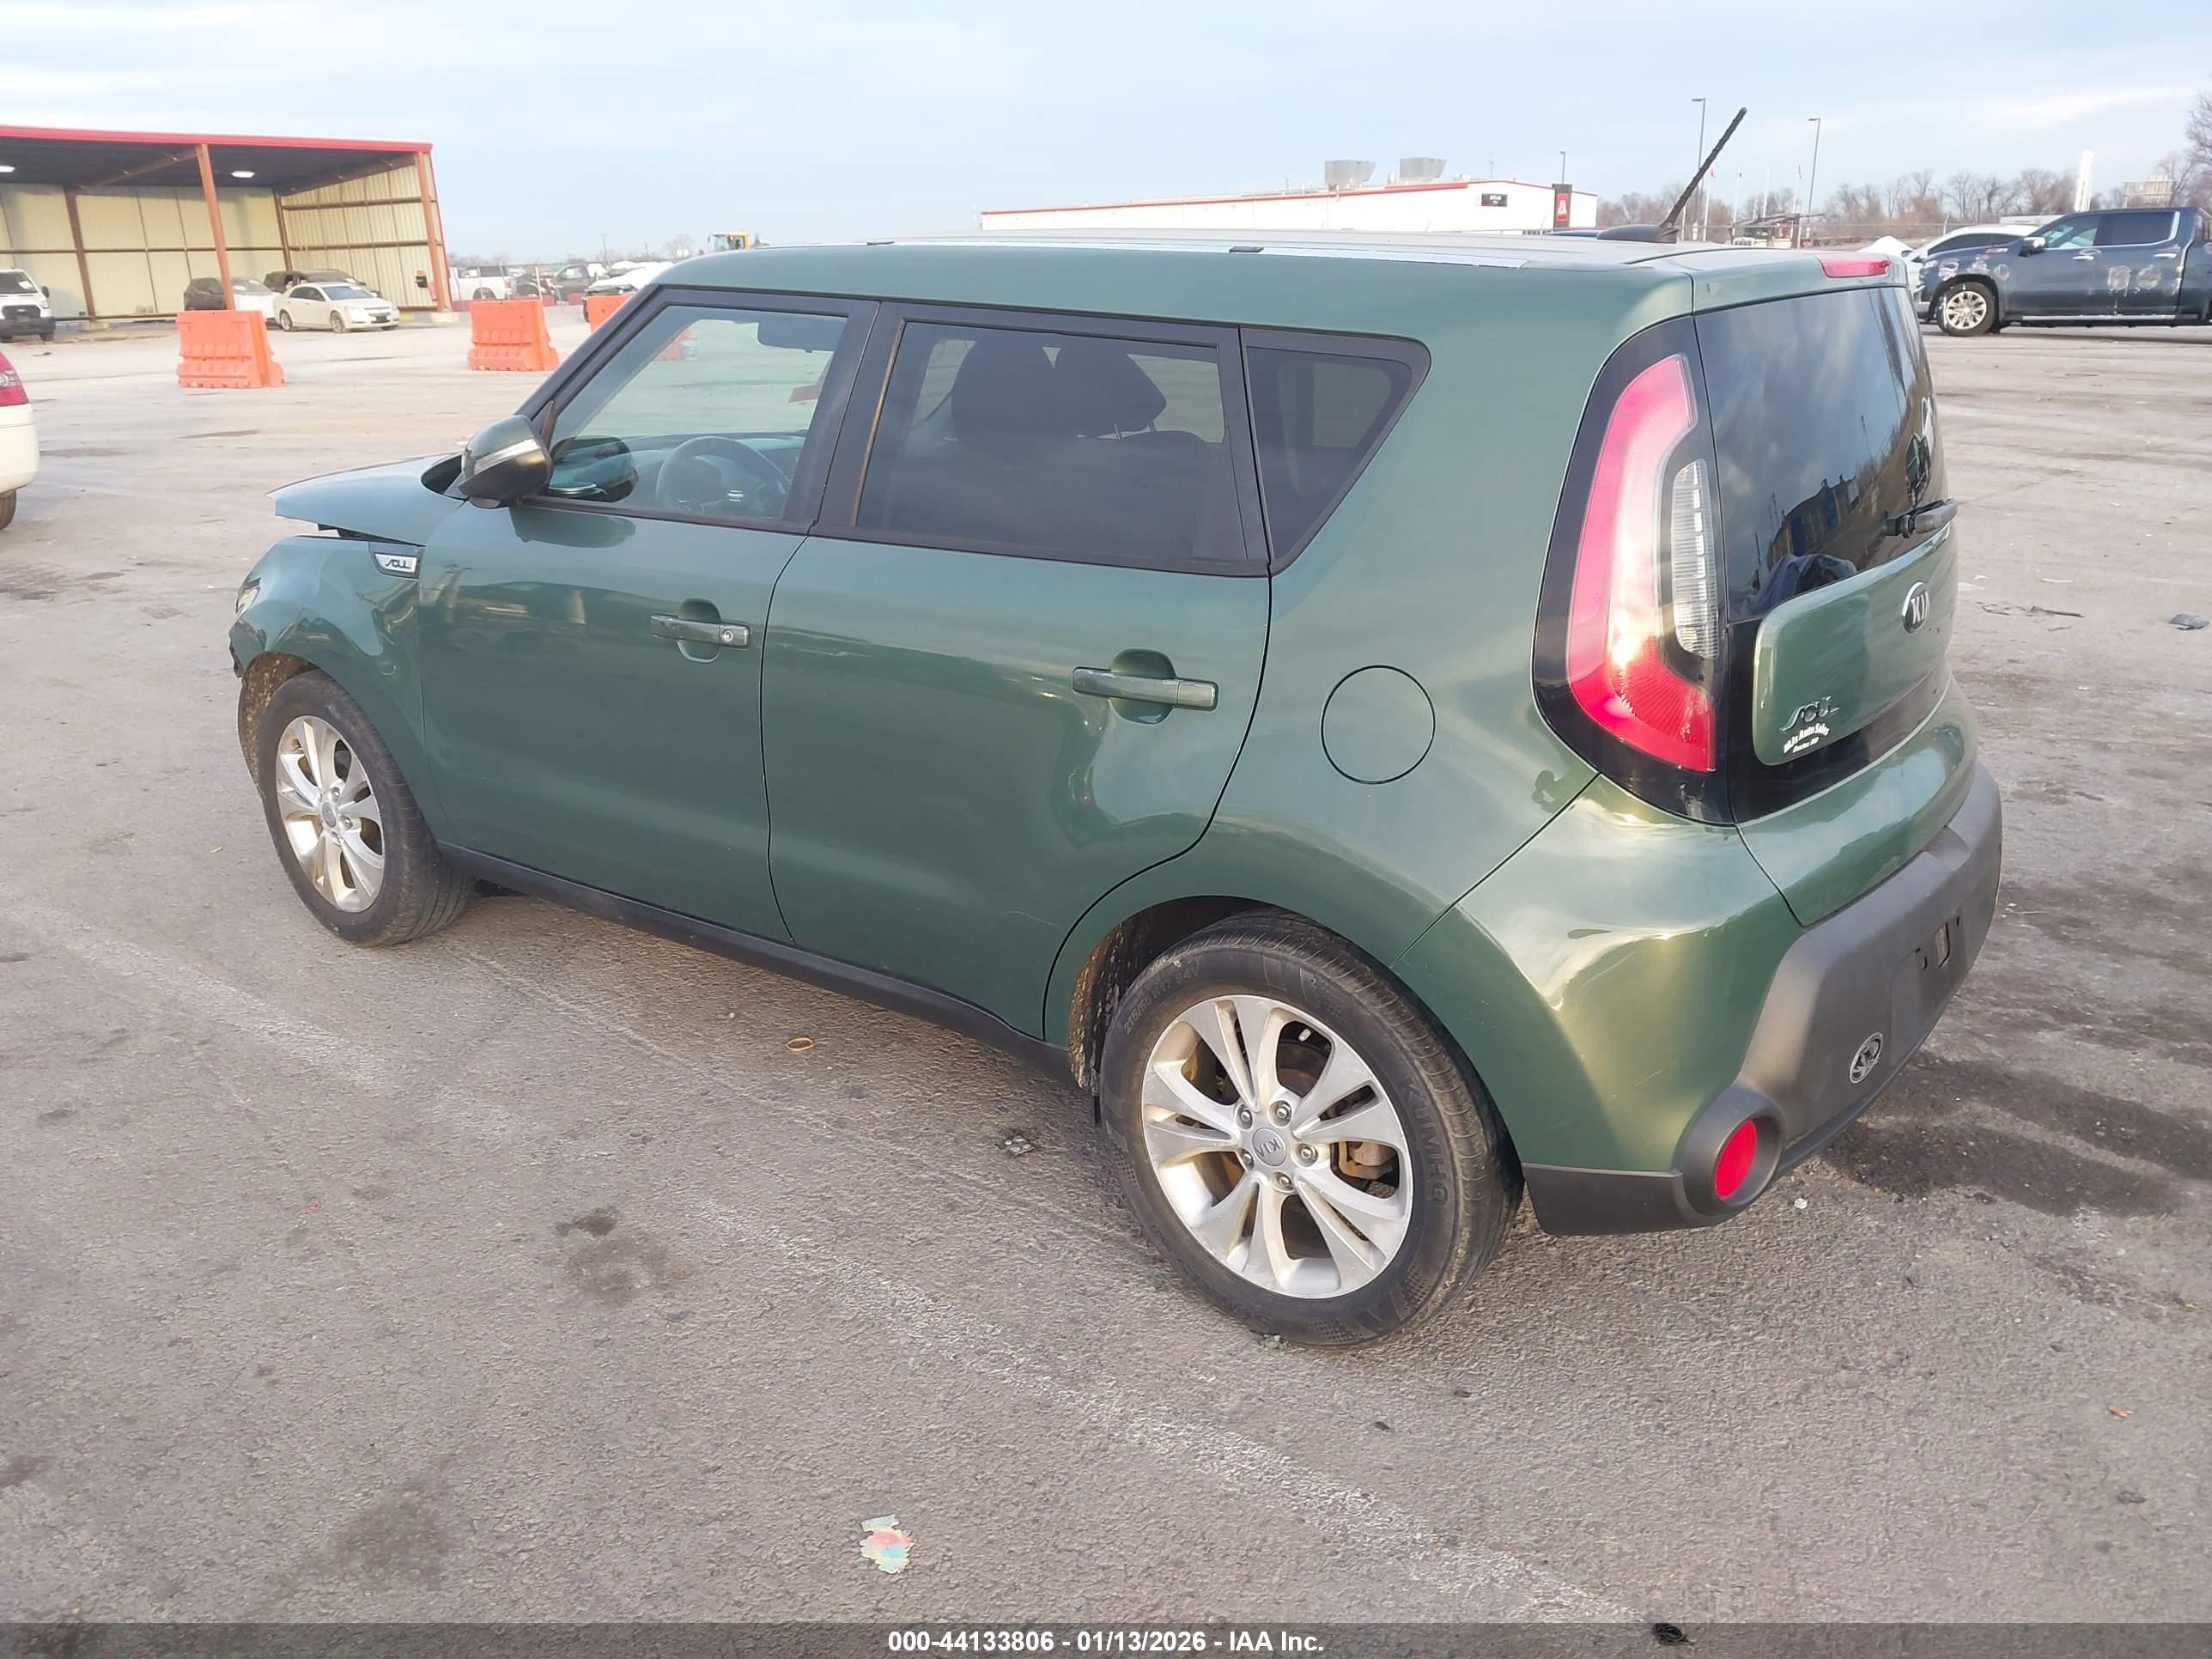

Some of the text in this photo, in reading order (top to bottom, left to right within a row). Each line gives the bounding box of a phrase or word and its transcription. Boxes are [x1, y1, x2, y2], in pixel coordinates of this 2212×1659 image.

[385, 558, 411, 569] SOUL
[1779, 696, 1840, 732] SOUL
[1799, 726, 1815, 741] Auto
[1255, 1138, 1282, 1157] KIA
[1401, 1079, 1449, 1206] KUMHO
